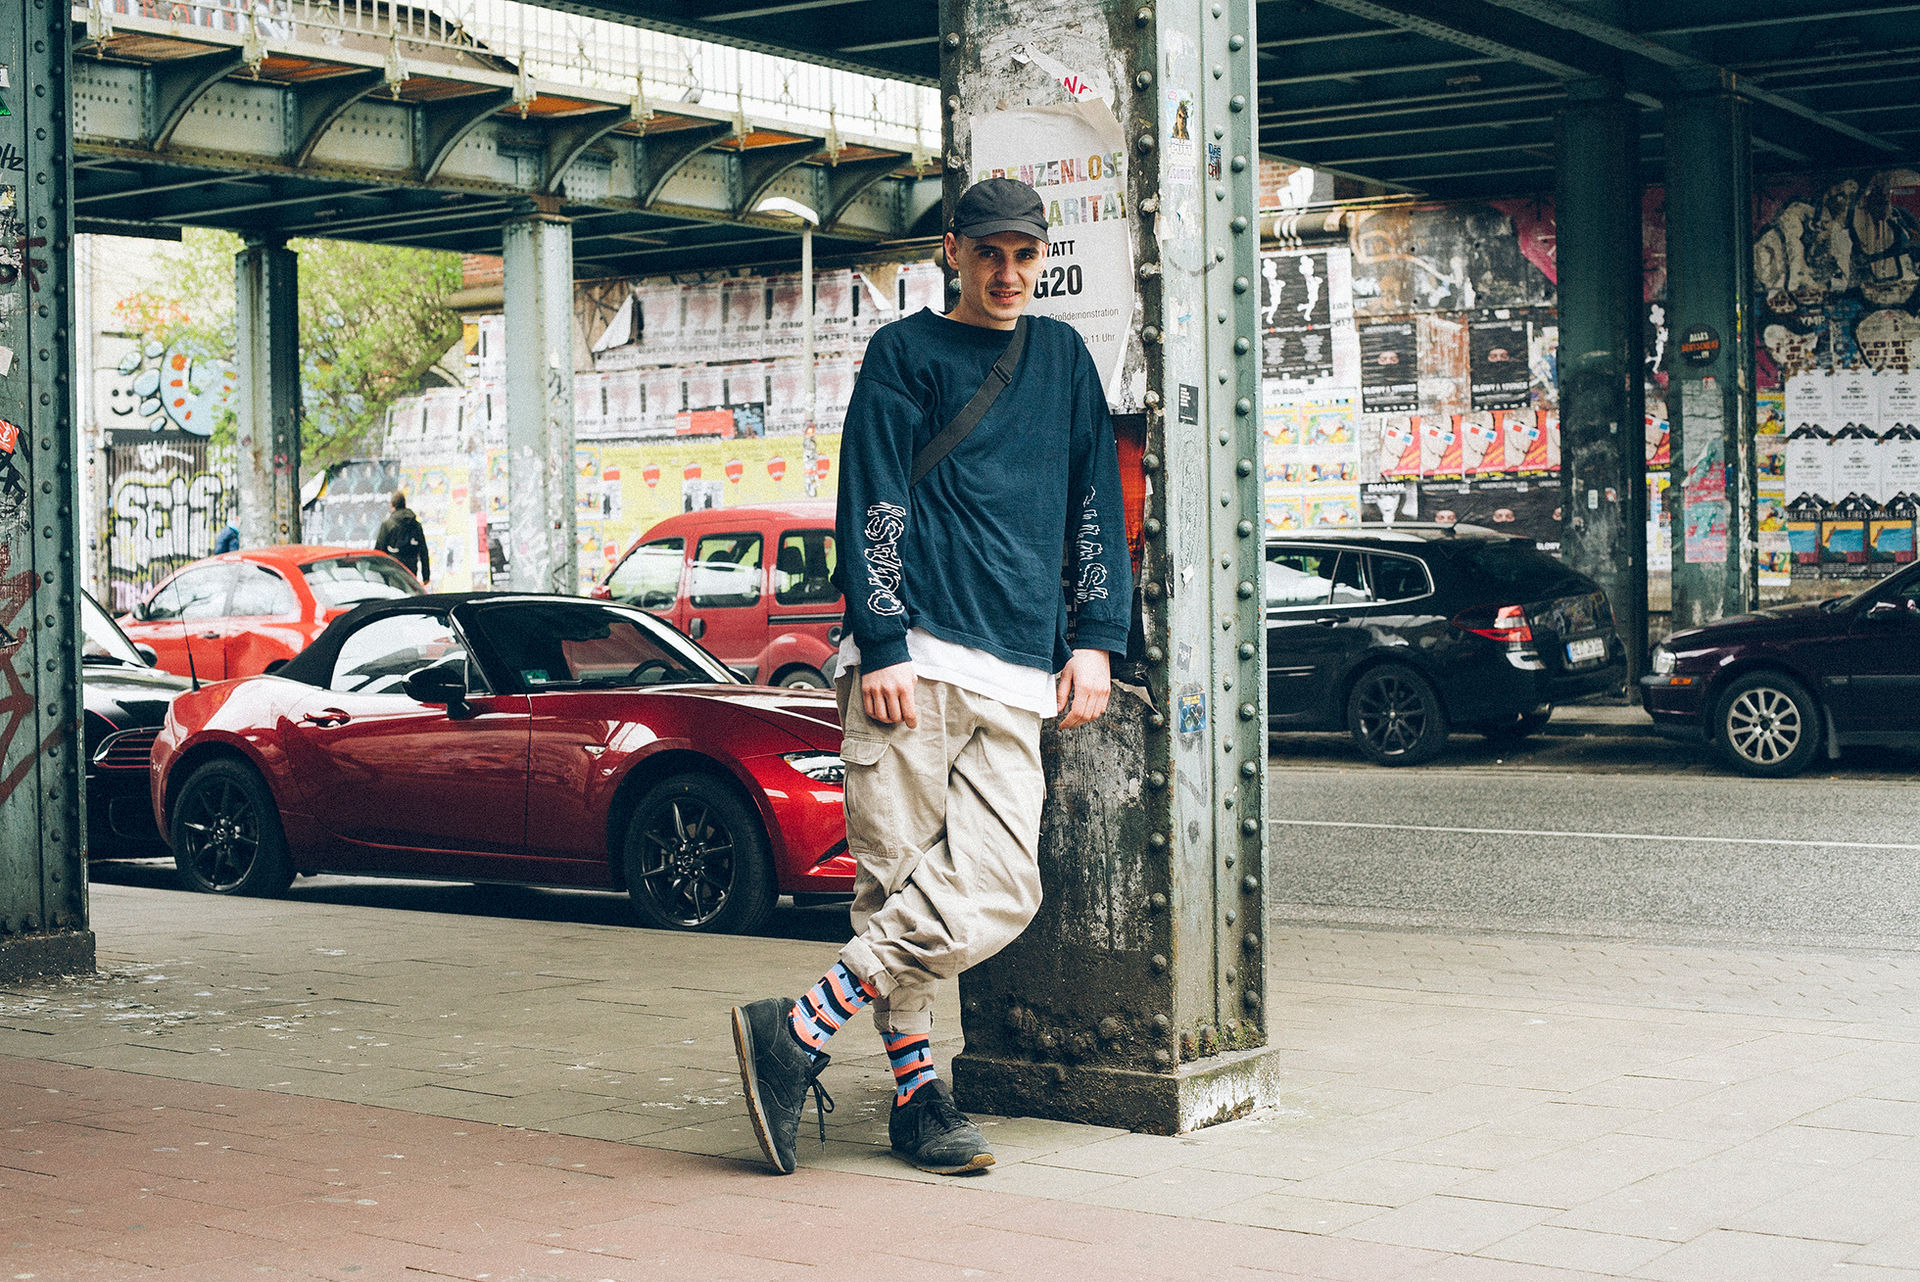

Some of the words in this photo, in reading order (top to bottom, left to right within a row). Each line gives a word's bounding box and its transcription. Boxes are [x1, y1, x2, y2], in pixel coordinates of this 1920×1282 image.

[1043, 185, 1126, 228] ARITÄT
[1047, 240, 1075, 258] TATT
[1033, 264, 1083, 299] G20
[1049, 308, 1119, 322] Großdemonstration
[1091, 334, 1098, 343] 11
[1102, 333, 1115, 342] Uhr
